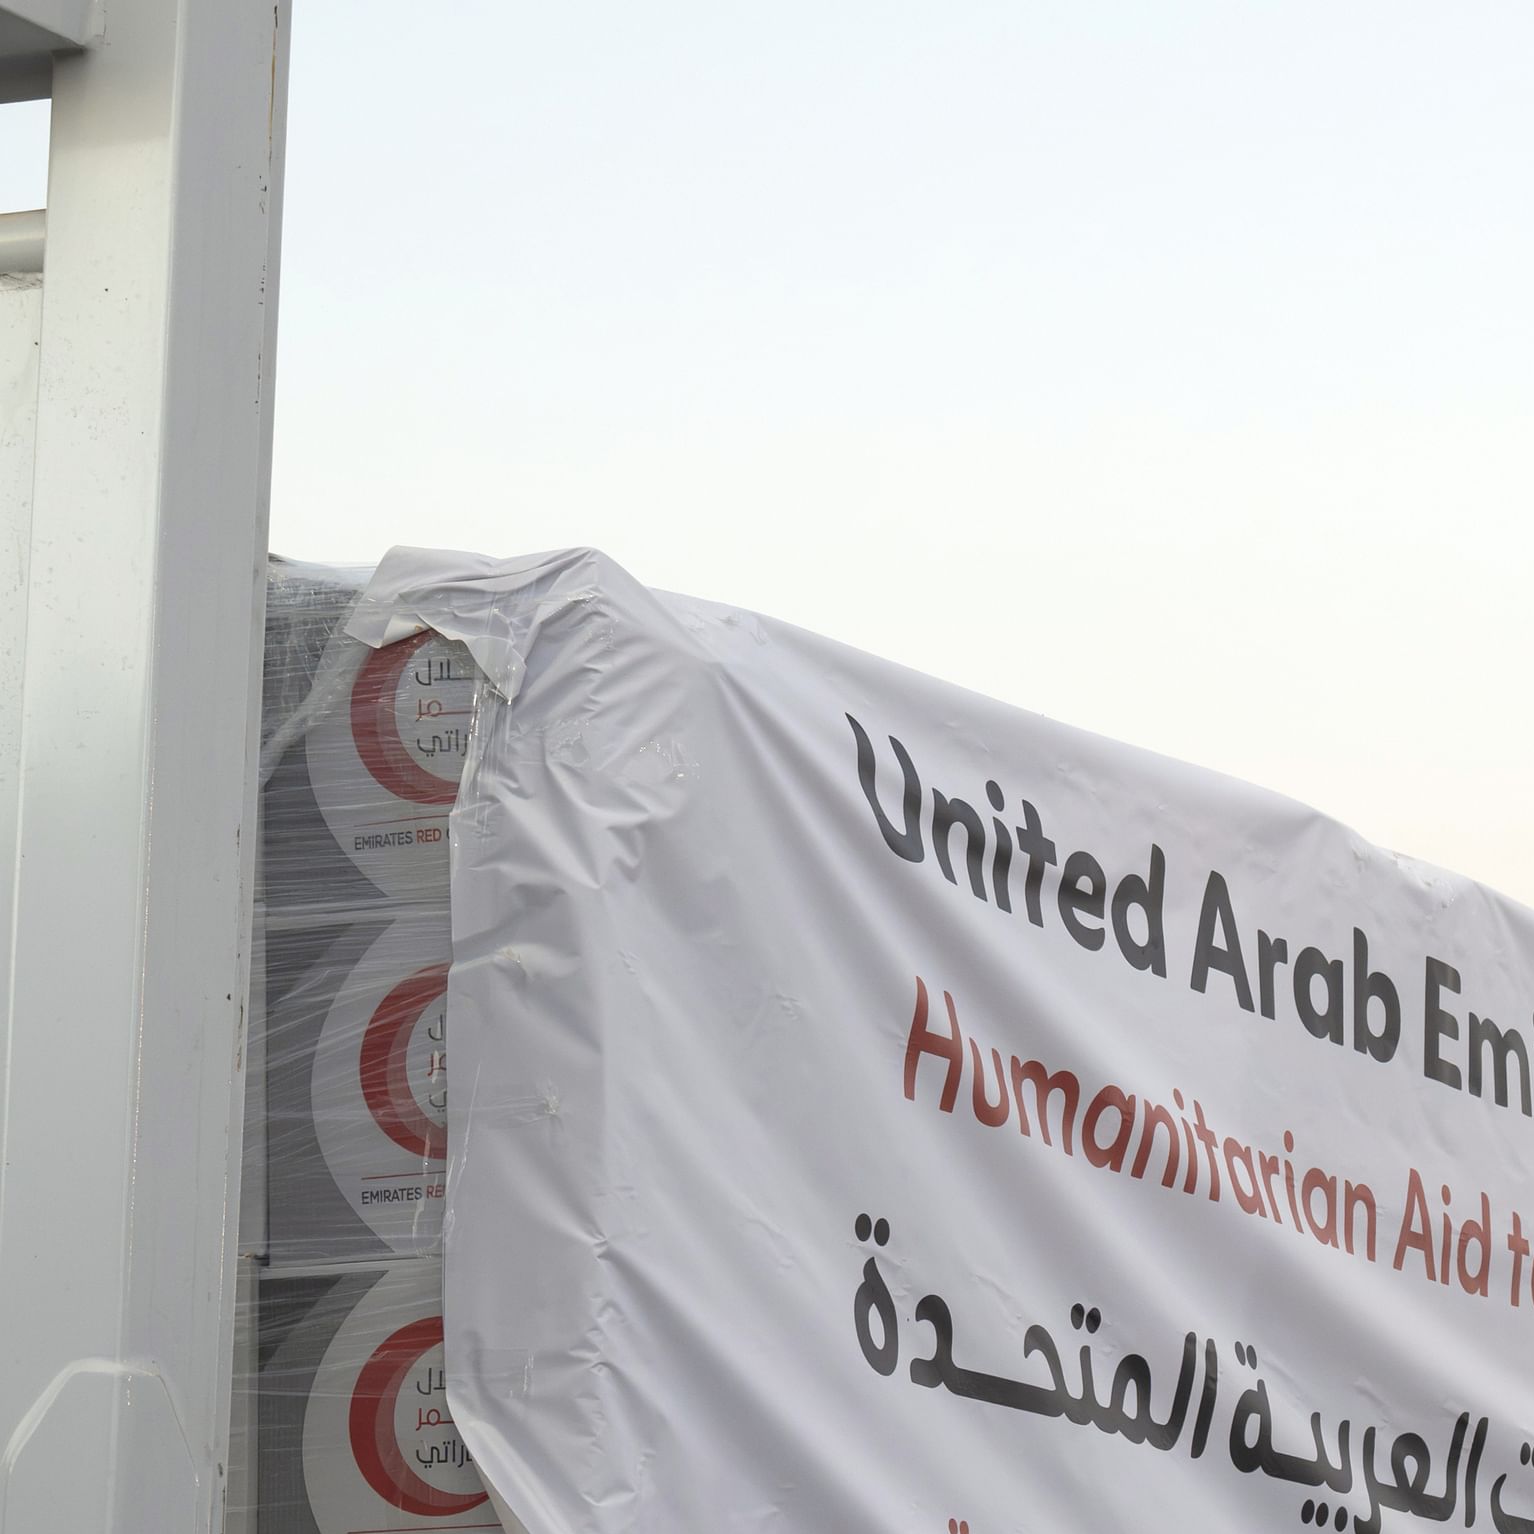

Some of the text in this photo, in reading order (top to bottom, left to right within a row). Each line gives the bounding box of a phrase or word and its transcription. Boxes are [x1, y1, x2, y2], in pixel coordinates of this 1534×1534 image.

[354, 831, 413, 851] EMIRATES
[416, 828, 441, 844] RED
[845, 711, 1167, 978] United
[1190, 870, 1401, 1063] Arab
[361, 1187, 422, 1204] EMIRATES
[904, 975, 1377, 1263] Humanitarian
[1393, 1168, 1491, 1297] Aid
[853, 1213, 1217, 1459] المتحدة
